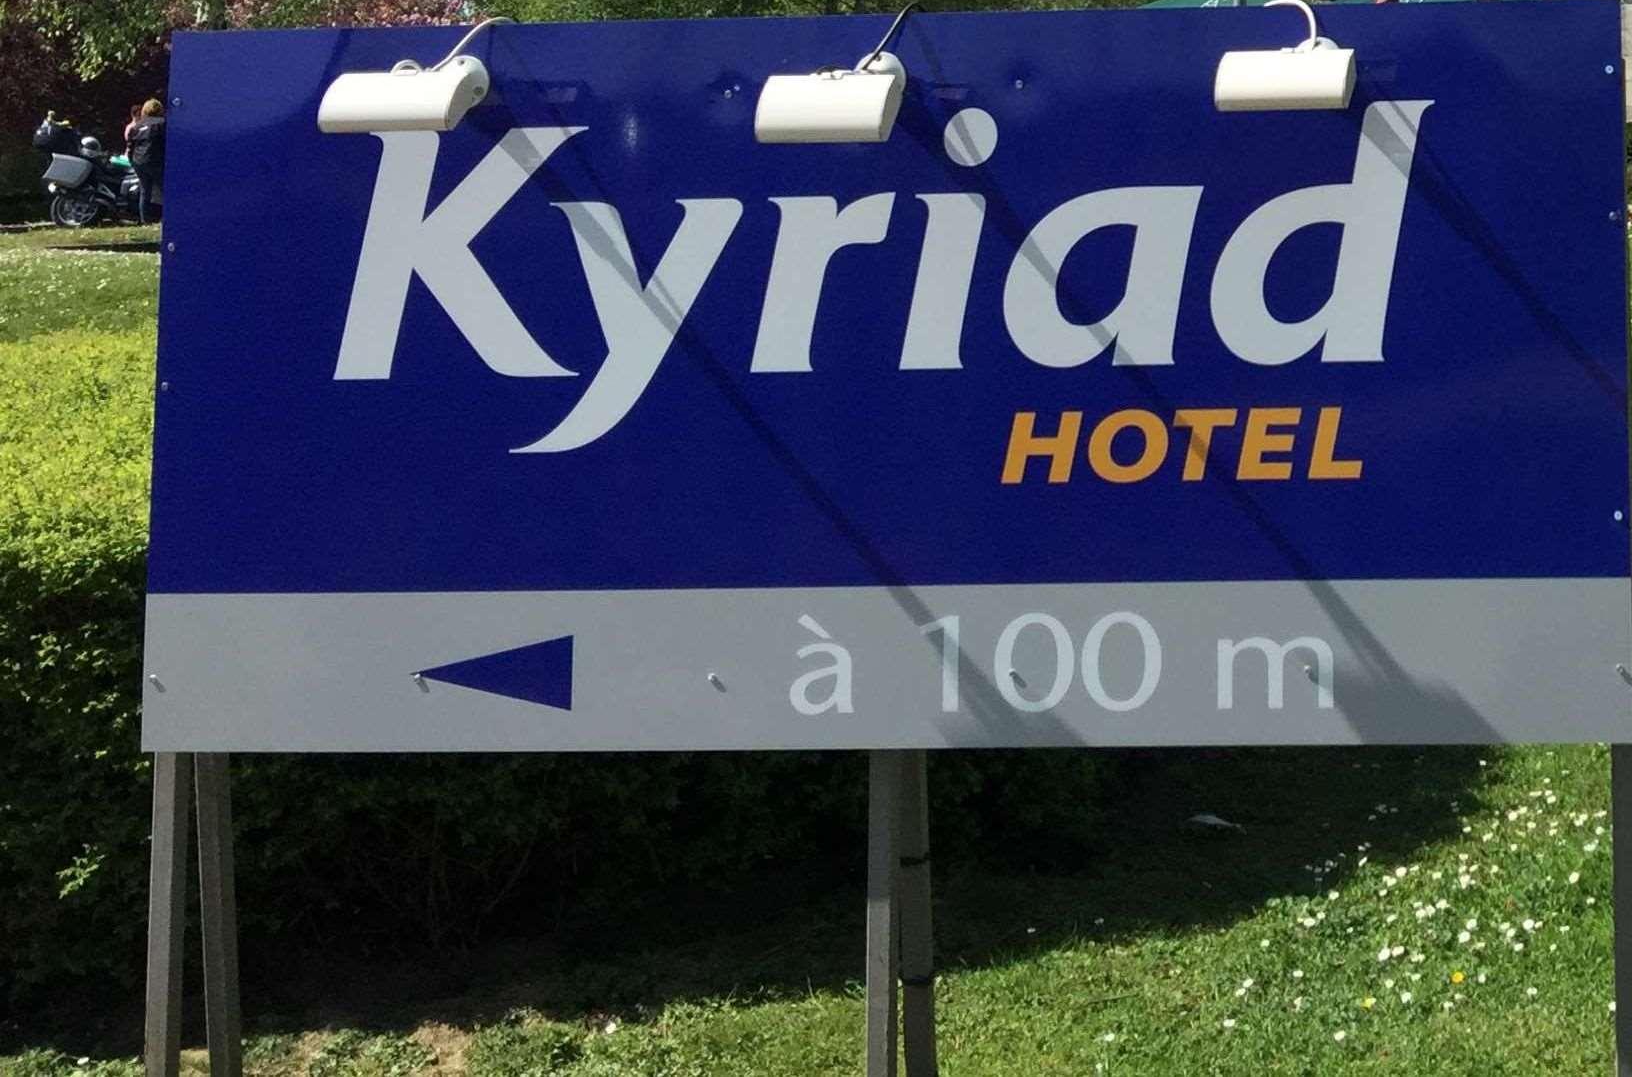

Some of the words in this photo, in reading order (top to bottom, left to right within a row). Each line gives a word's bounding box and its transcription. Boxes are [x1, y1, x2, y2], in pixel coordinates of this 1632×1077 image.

[333, 100, 1434, 453] Kyriad
[1002, 408, 1362, 483] HOTEL
[789, 613, 854, 715] à
[920, 611, 1162, 712] 100
[1217, 636, 1334, 709] m
